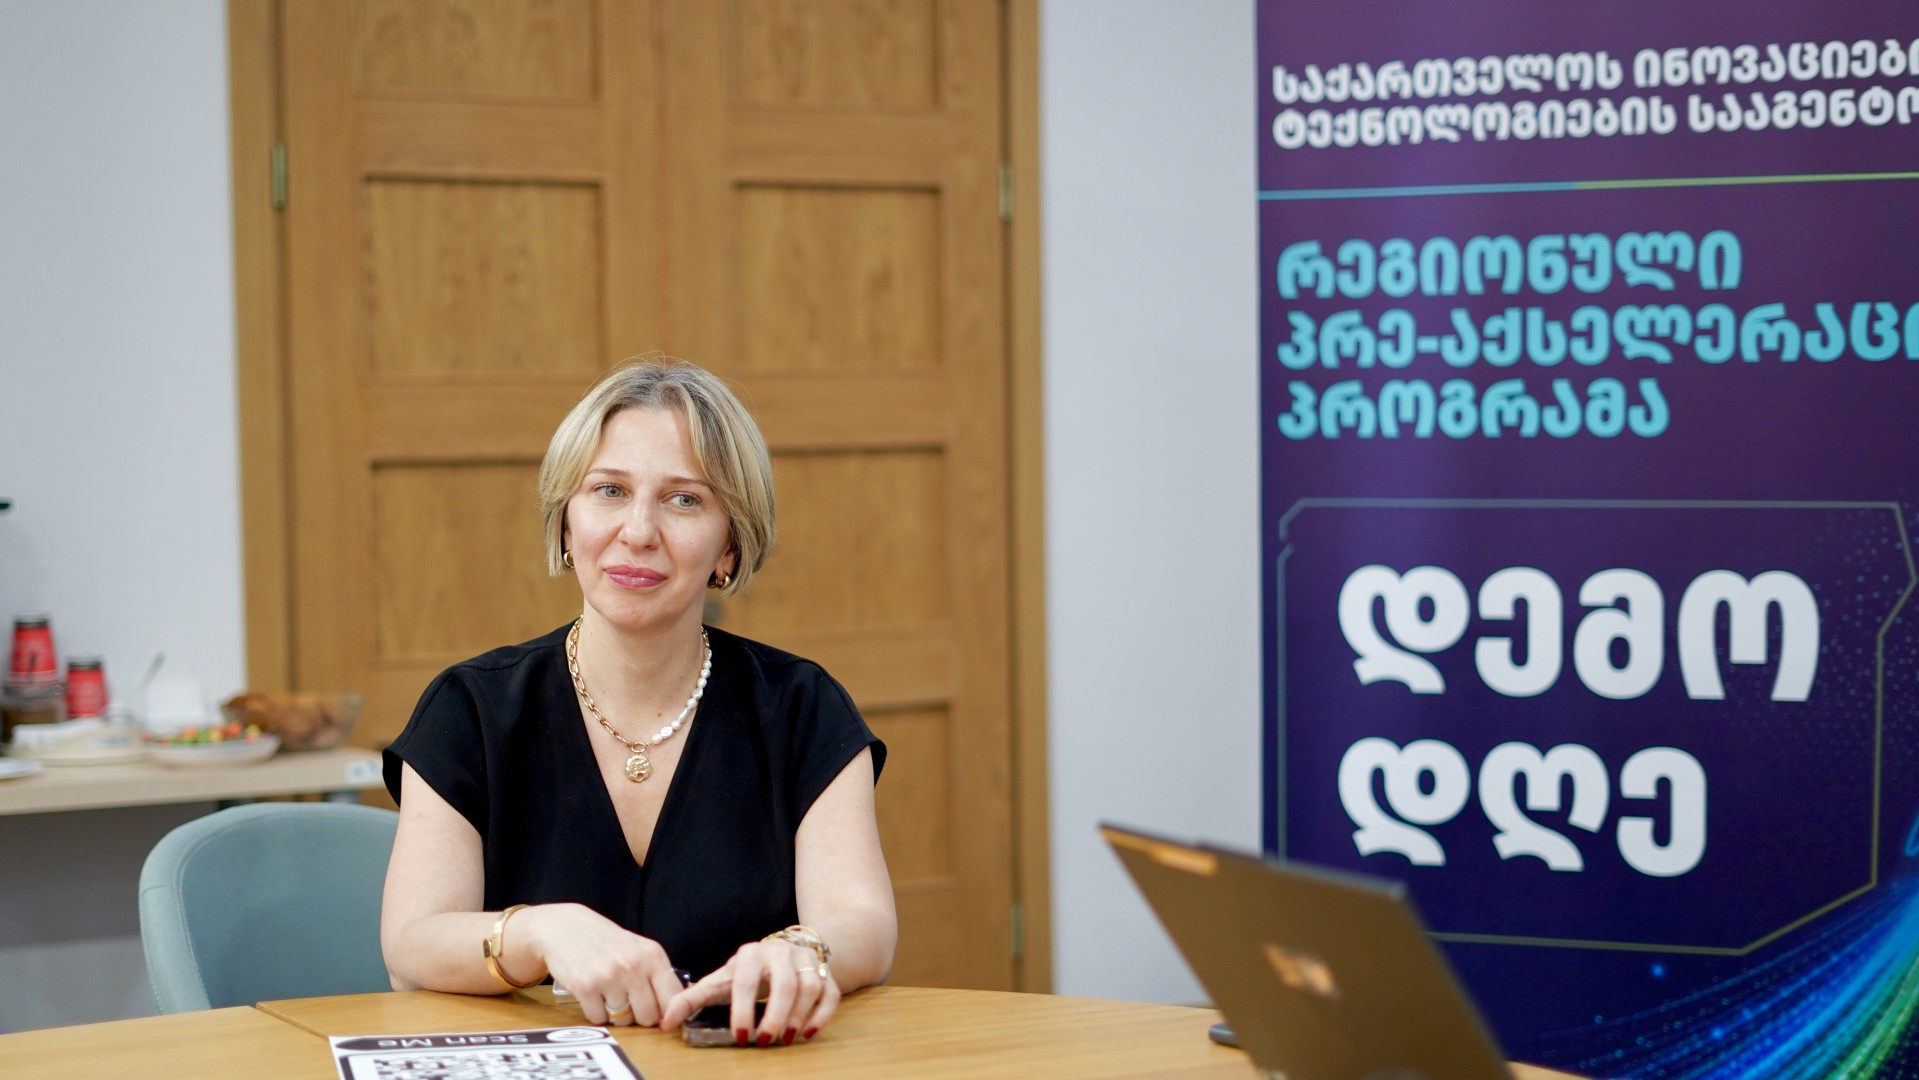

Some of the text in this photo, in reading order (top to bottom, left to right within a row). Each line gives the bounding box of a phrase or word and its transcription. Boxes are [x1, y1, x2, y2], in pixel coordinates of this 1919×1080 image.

[1273, 51, 1623, 103] საქართველოს
[1272, 94, 1677, 149] ტექნოლოგიების
[1277, 231, 1742, 298] რეგიონული
[1277, 378, 1670, 439] პროგრამა
[1338, 564, 1820, 702] დემო
[1338, 737, 1707, 878] დღე
[378, 1034, 528, 1048] Scan Me
